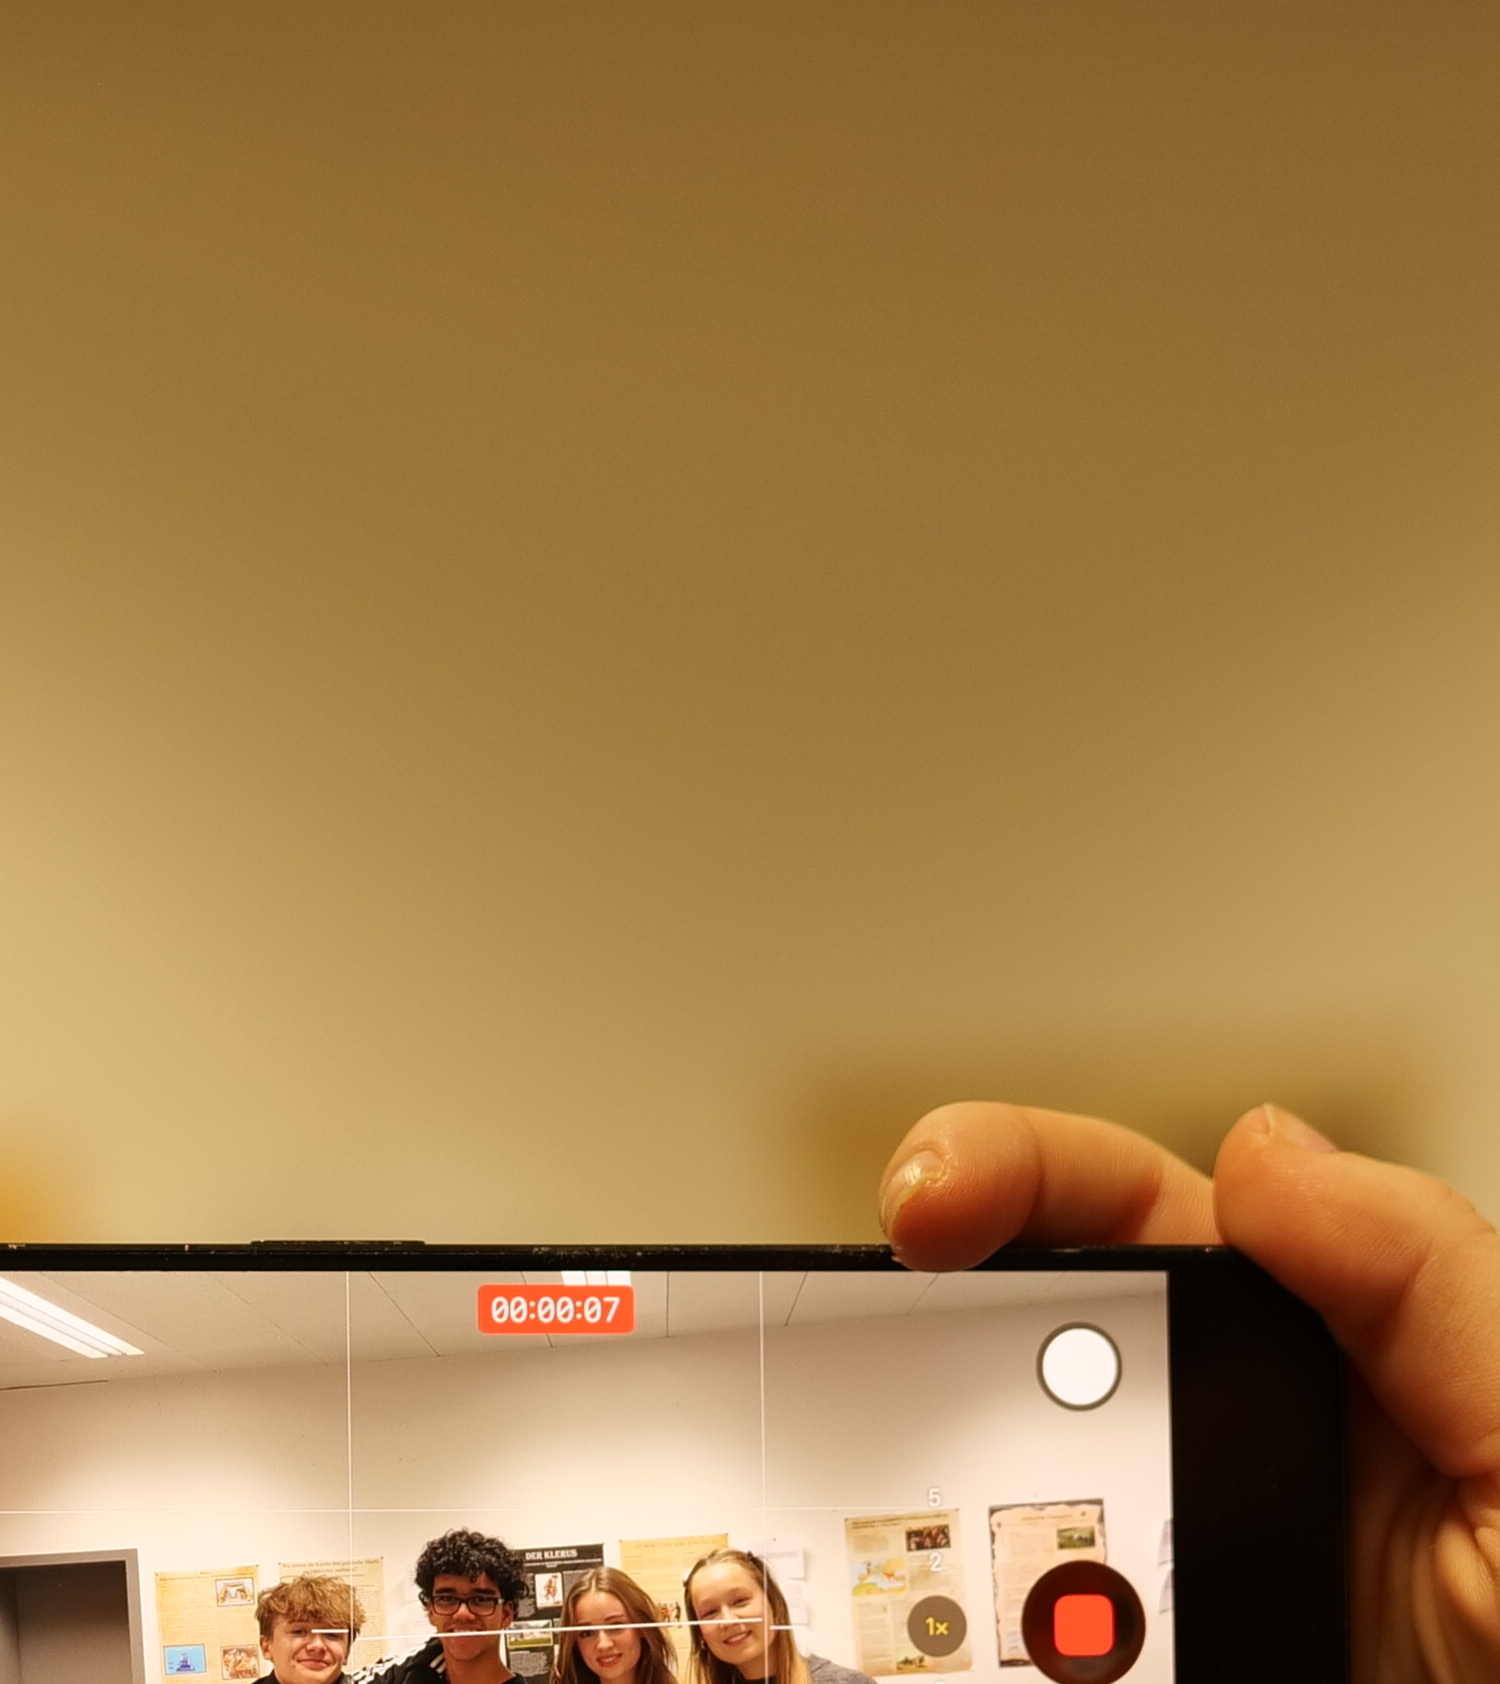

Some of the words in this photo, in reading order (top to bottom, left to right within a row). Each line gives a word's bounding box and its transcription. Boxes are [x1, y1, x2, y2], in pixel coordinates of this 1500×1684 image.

[491, 1296, 621, 1324] 00:00:07
[927, 1487, 942, 1508] 5
[525, 1551, 543, 1561] DER
[543, 1548, 578, 1560] KLERUS
[929, 1552, 943, 1572] 2
[925, 1616, 949, 1636] 1x
